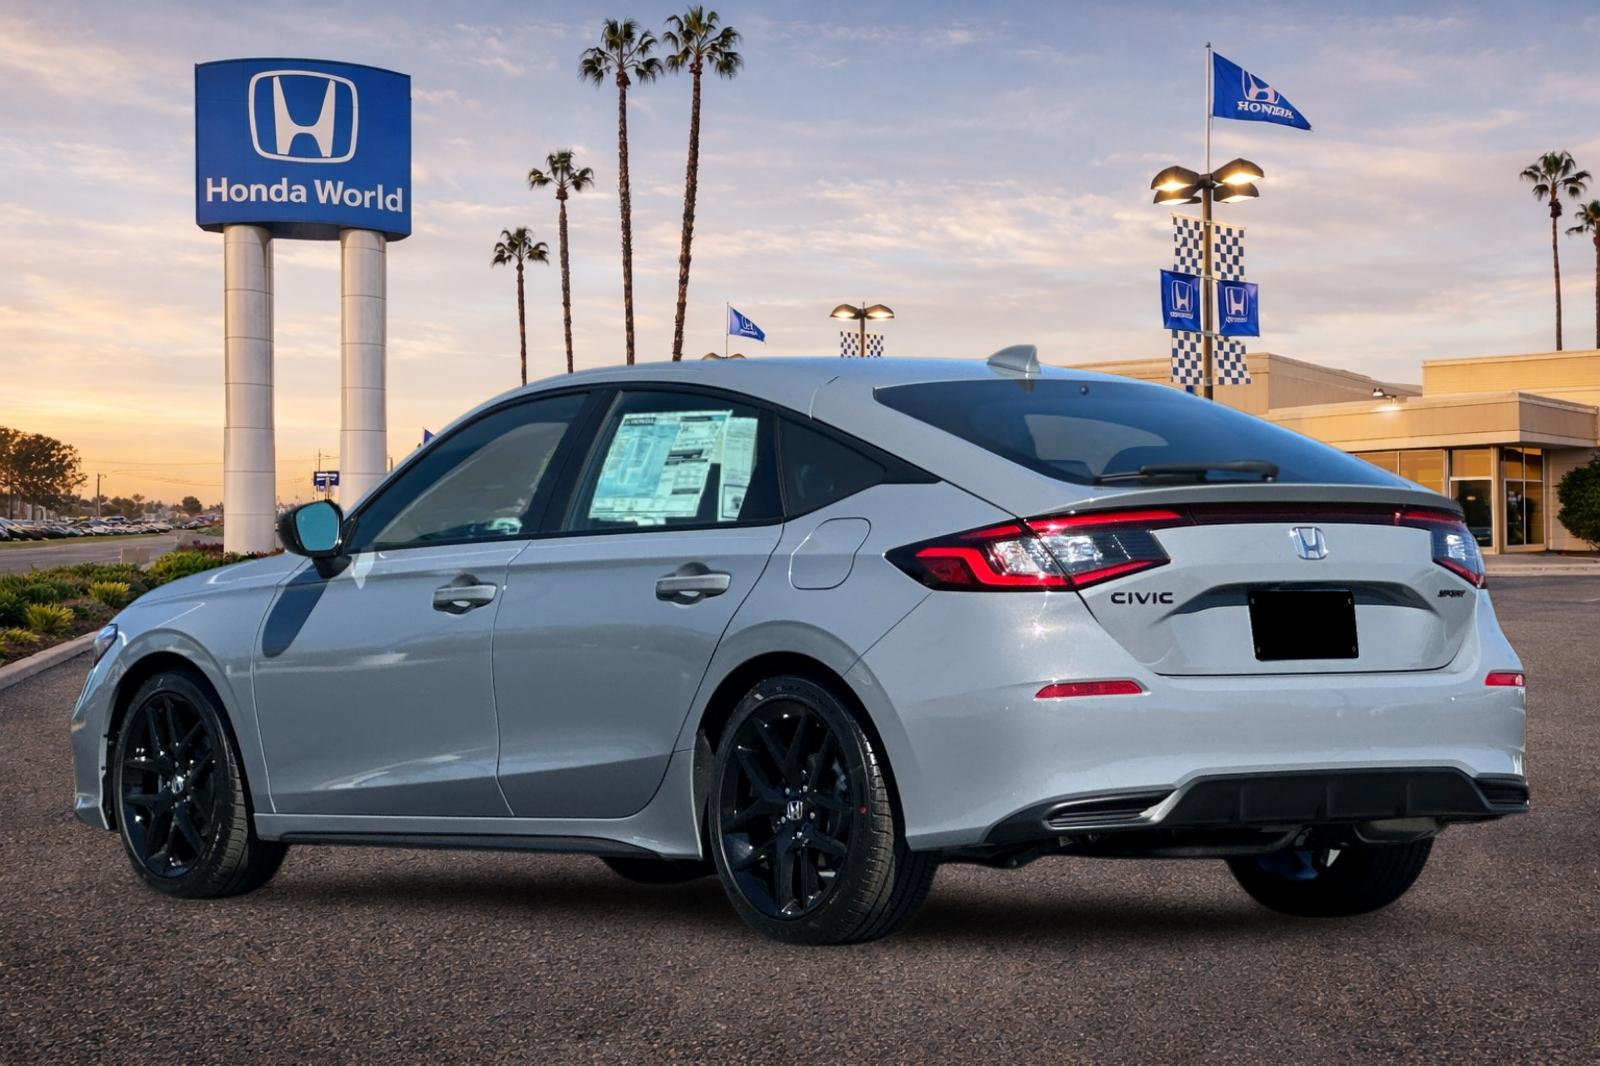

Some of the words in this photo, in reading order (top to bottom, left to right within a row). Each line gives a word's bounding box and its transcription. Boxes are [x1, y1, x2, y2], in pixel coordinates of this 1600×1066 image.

[206, 177, 307, 203] Honda
[313, 179, 403, 213] World
[1110, 592, 1174, 604] CIVIC
